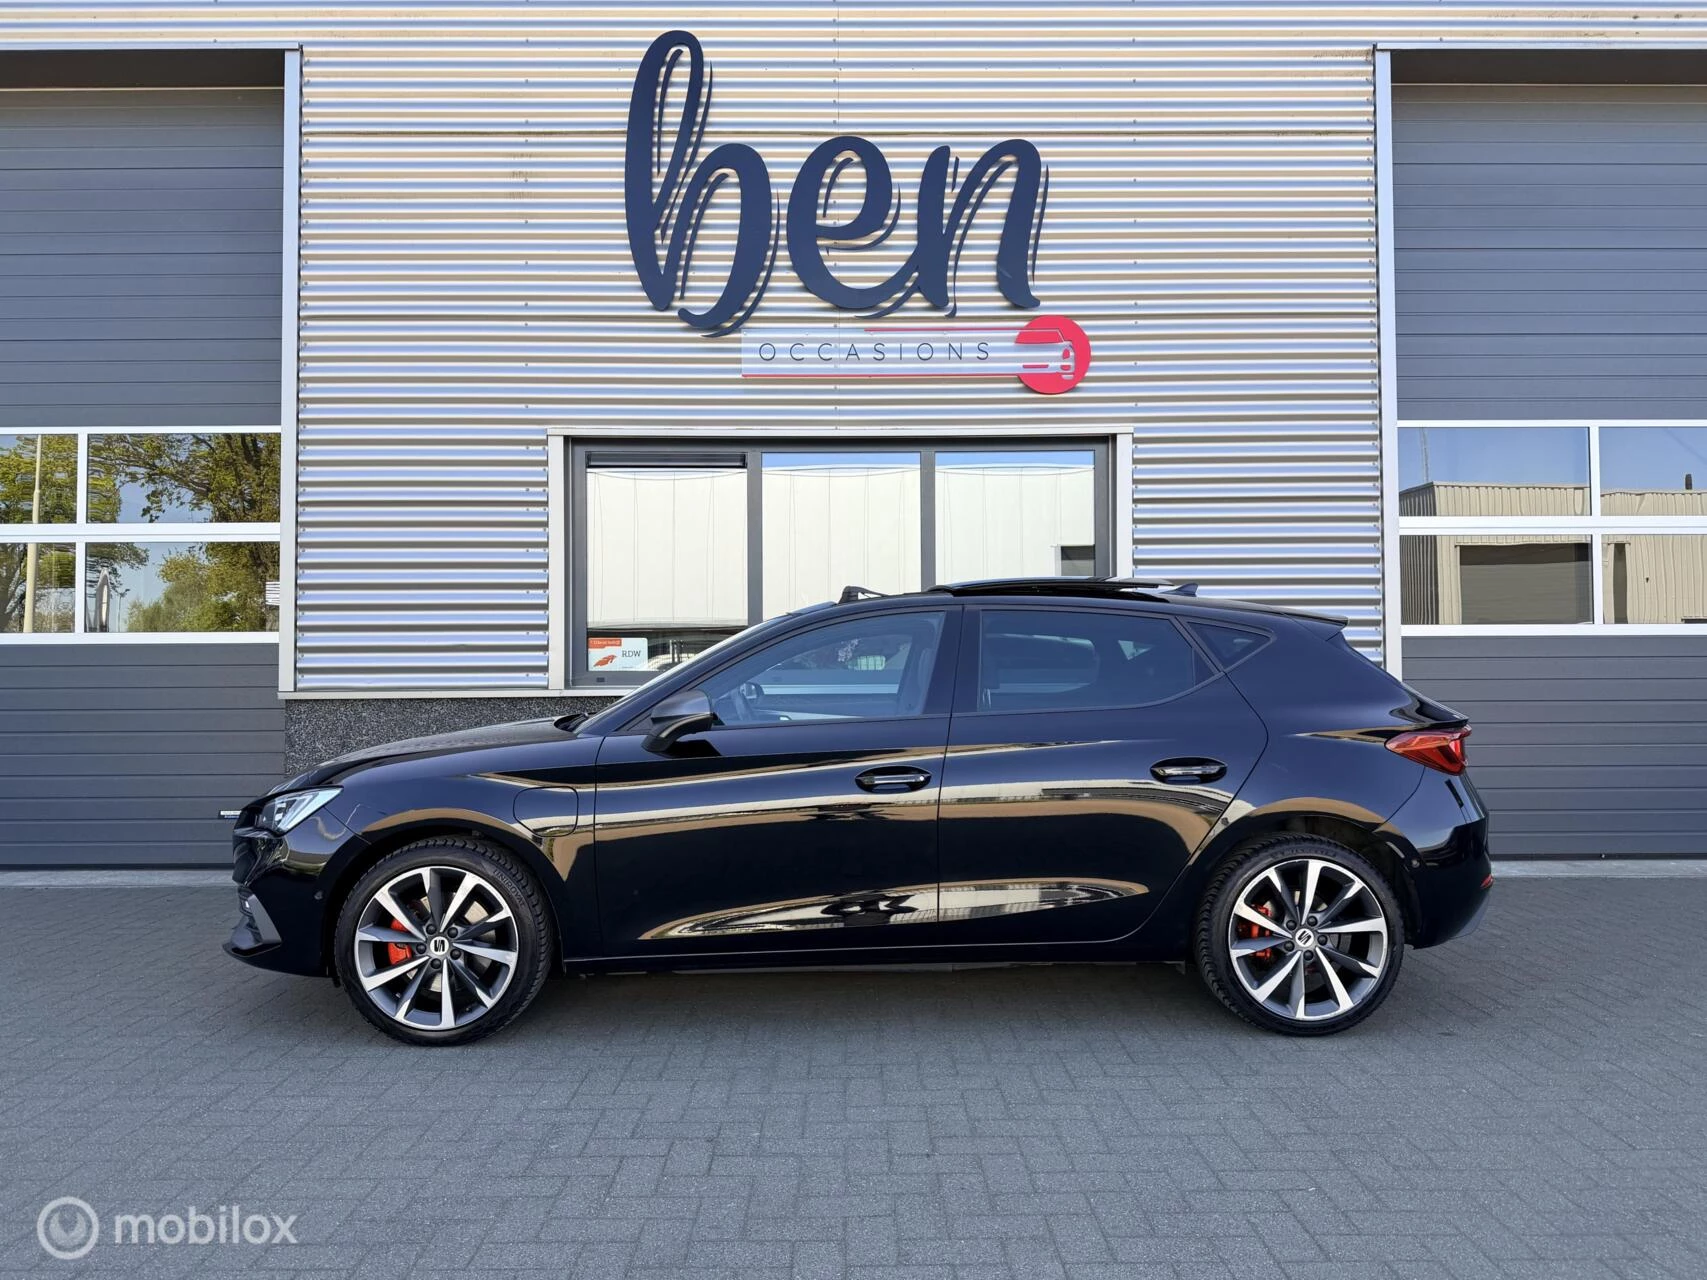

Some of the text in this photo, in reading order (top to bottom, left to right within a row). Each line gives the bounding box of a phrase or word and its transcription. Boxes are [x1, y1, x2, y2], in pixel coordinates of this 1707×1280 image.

[625, 30, 1047, 335] ben
[758, 342, 990, 362] OCCASIONS
[621, 650, 642, 658] RDW
[493, 869, 525, 907] UNIROYAL
